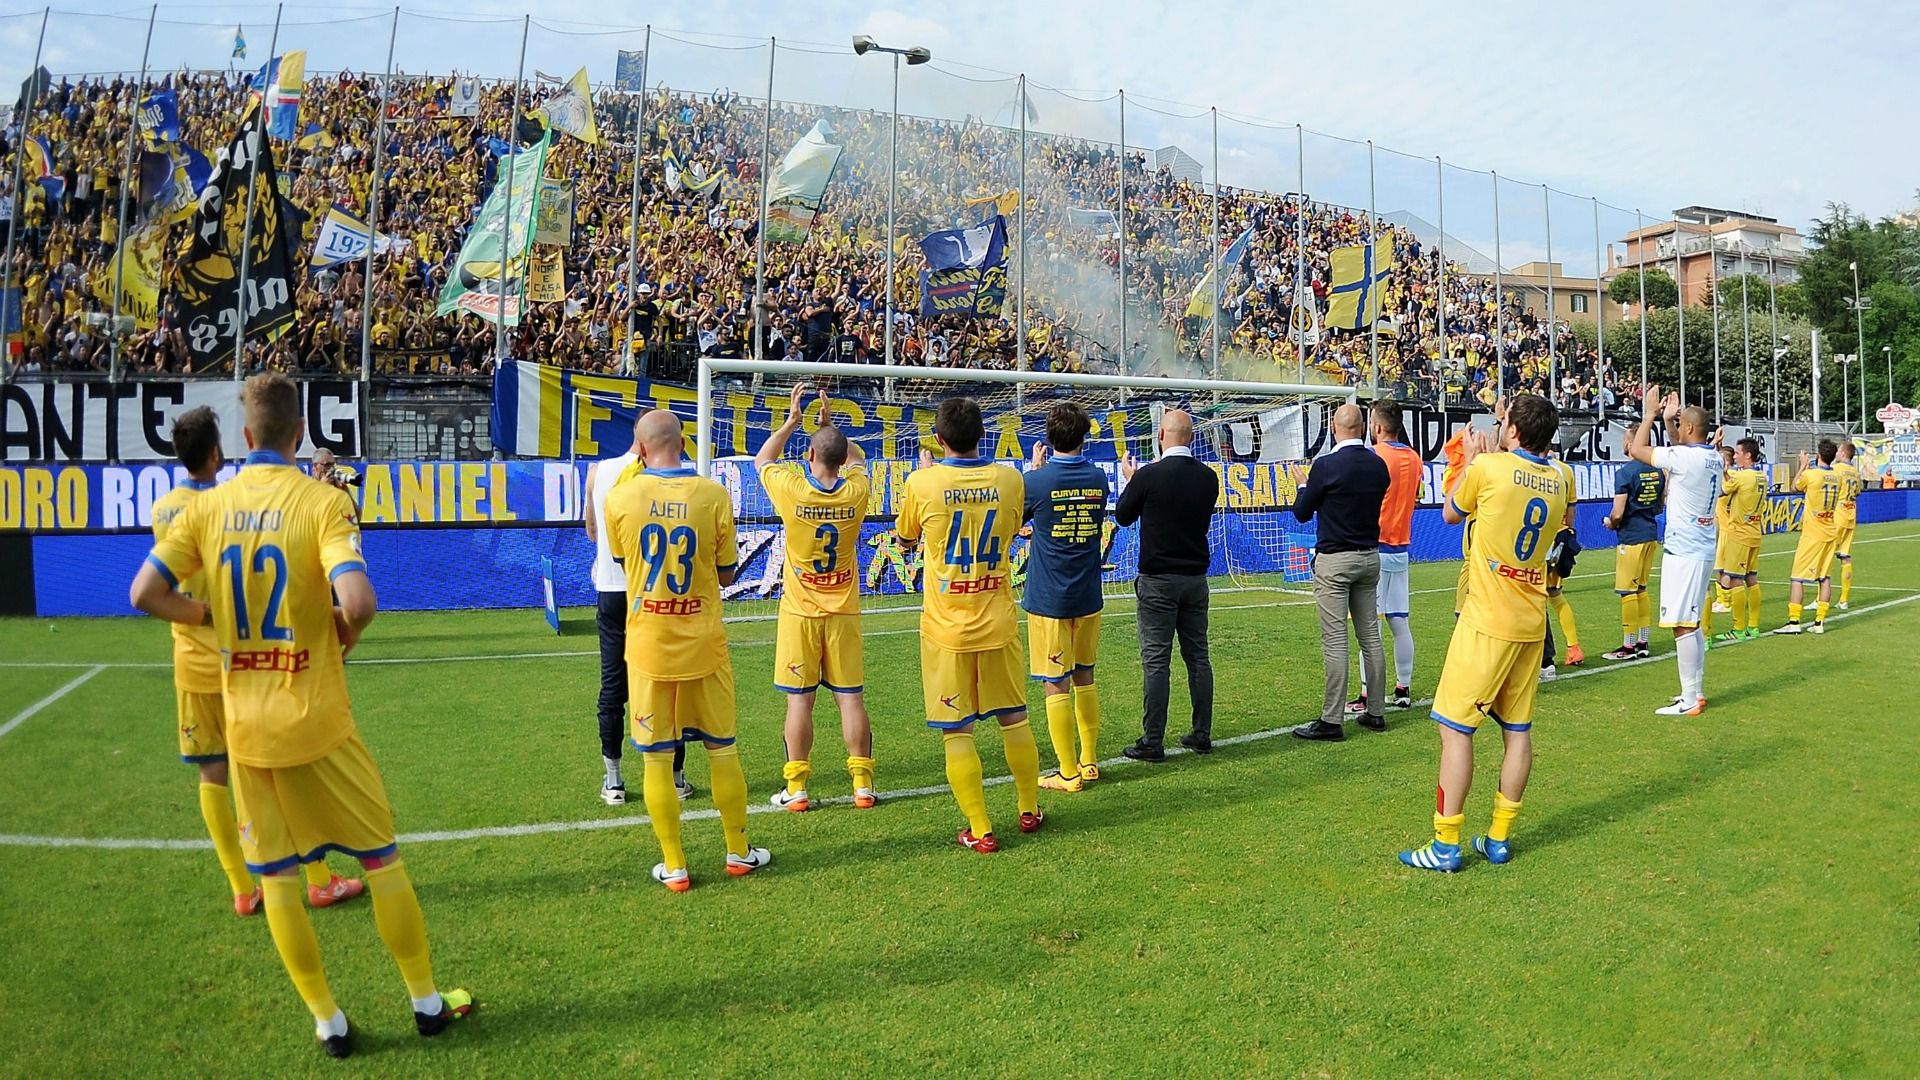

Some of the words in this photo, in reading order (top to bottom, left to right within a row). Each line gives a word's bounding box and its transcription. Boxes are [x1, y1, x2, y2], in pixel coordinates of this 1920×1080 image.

[325, 231, 378, 255] 197
[534, 263, 560, 274] NORD
[543, 275, 551, 283] E
[534, 283, 561, 292] CASA
[540, 293, 557, 301] MIA
[1891, 443, 1917, 454] CLUB
[1051, 489, 1080, 499] CURVA
[1082, 488, 1103, 497] NORD
[1513, 469, 1561, 496] GUCHER
[1706, 473, 1718, 515] 1
[944, 487, 1000, 505] PRYYMA
[1755, 484, 1765, 513] 7
[1821, 483, 1838, 511] 11
[224, 510, 282, 532] LONGO
[650, 500, 688, 519] AJETI
[795, 506, 856, 519] CRIVELLO
[1514, 497, 1549, 562] 8
[813, 523, 839, 574] 3
[944, 509, 1003, 574] 44
[640, 522, 698, 596] 93
[220, 543, 295, 641] 12
[643, 597, 702, 615] sette
[231, 647, 310, 674] sette
